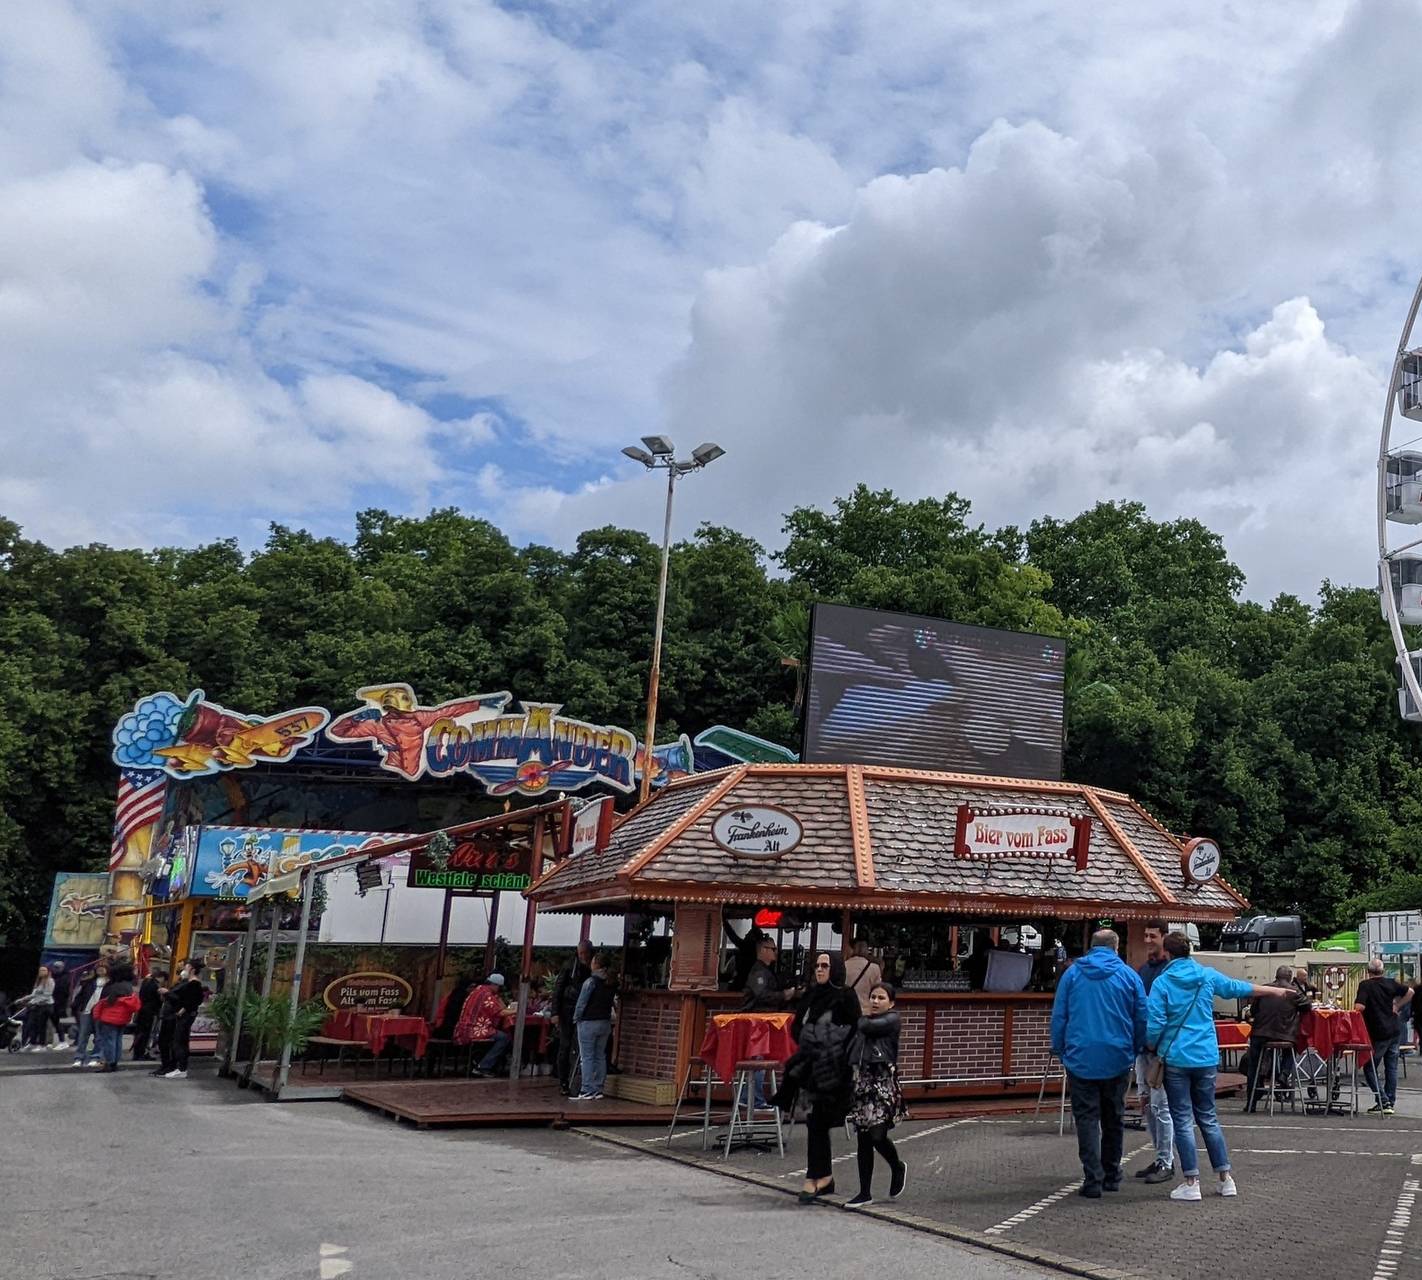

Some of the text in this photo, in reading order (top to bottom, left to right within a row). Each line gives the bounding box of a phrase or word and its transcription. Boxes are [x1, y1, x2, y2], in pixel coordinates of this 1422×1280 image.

[274, 716, 310, 737] 537
[727, 821, 789, 845] Frankenheim
[974, 822, 1068, 848] Bier vom Fass
[763, 839, 780, 852] Alt
[340, 987, 400, 997] Pils vom Fass
[340, 996, 355, 1006] Alt
